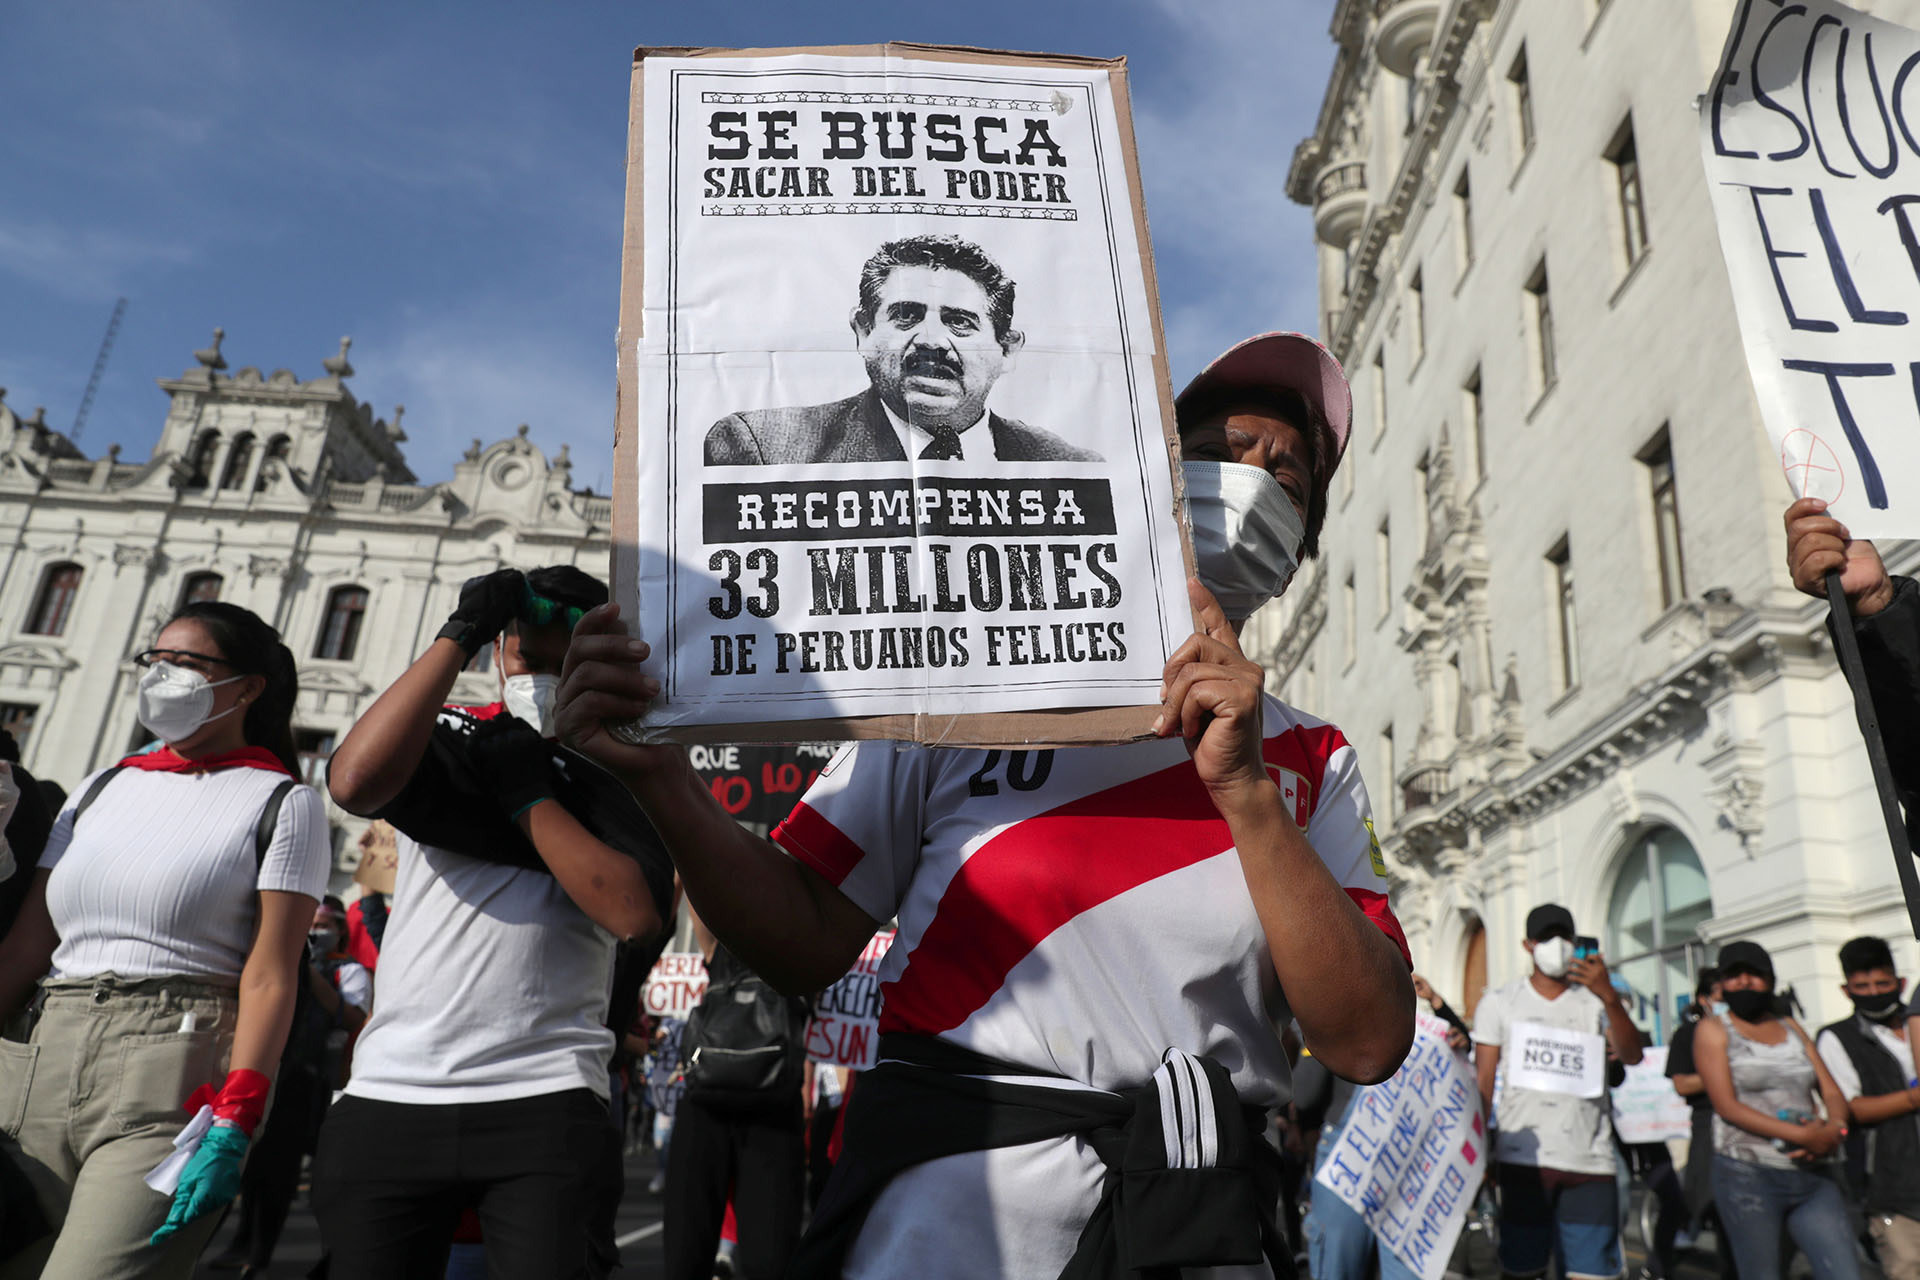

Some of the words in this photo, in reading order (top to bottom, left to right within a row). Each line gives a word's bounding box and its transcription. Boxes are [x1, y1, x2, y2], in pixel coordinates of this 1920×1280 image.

[708, 110, 798, 160] SE
[822, 110, 1067, 167] BUSCA
[704, 166, 833, 199] SACAR
[853, 166, 926, 197] DEL
[946, 168, 1071, 204] PODER
[1720, 183, 1909, 333] EL
[737, 489, 1085, 530] RECOMPENSA
[708, 547, 779, 620] 33
[807, 542, 1122, 616] MILLONES
[710, 633, 756, 676] DE
[775, 625, 969, 674] PERUANOS
[985, 622, 1128, 668] FELICES
[689, 744, 741, 770] QUE
[761, 762, 802, 794] LO
[805, 1018, 835, 1060] ES
[838, 1022, 872, 1066] UN
[1524, 1049, 1554, 1065] NO
[1560, 1053, 1584, 1071] ES
[1408, 1046, 1451, 1108] PAZ
[1328, 1152, 1364, 1198] SI
[1347, 1123, 1380, 1162] EL
[1372, 1101, 1422, 1179] TIENE
[1361, 1178, 1388, 1225] NO
[1379, 1207, 1410, 1246] EL
